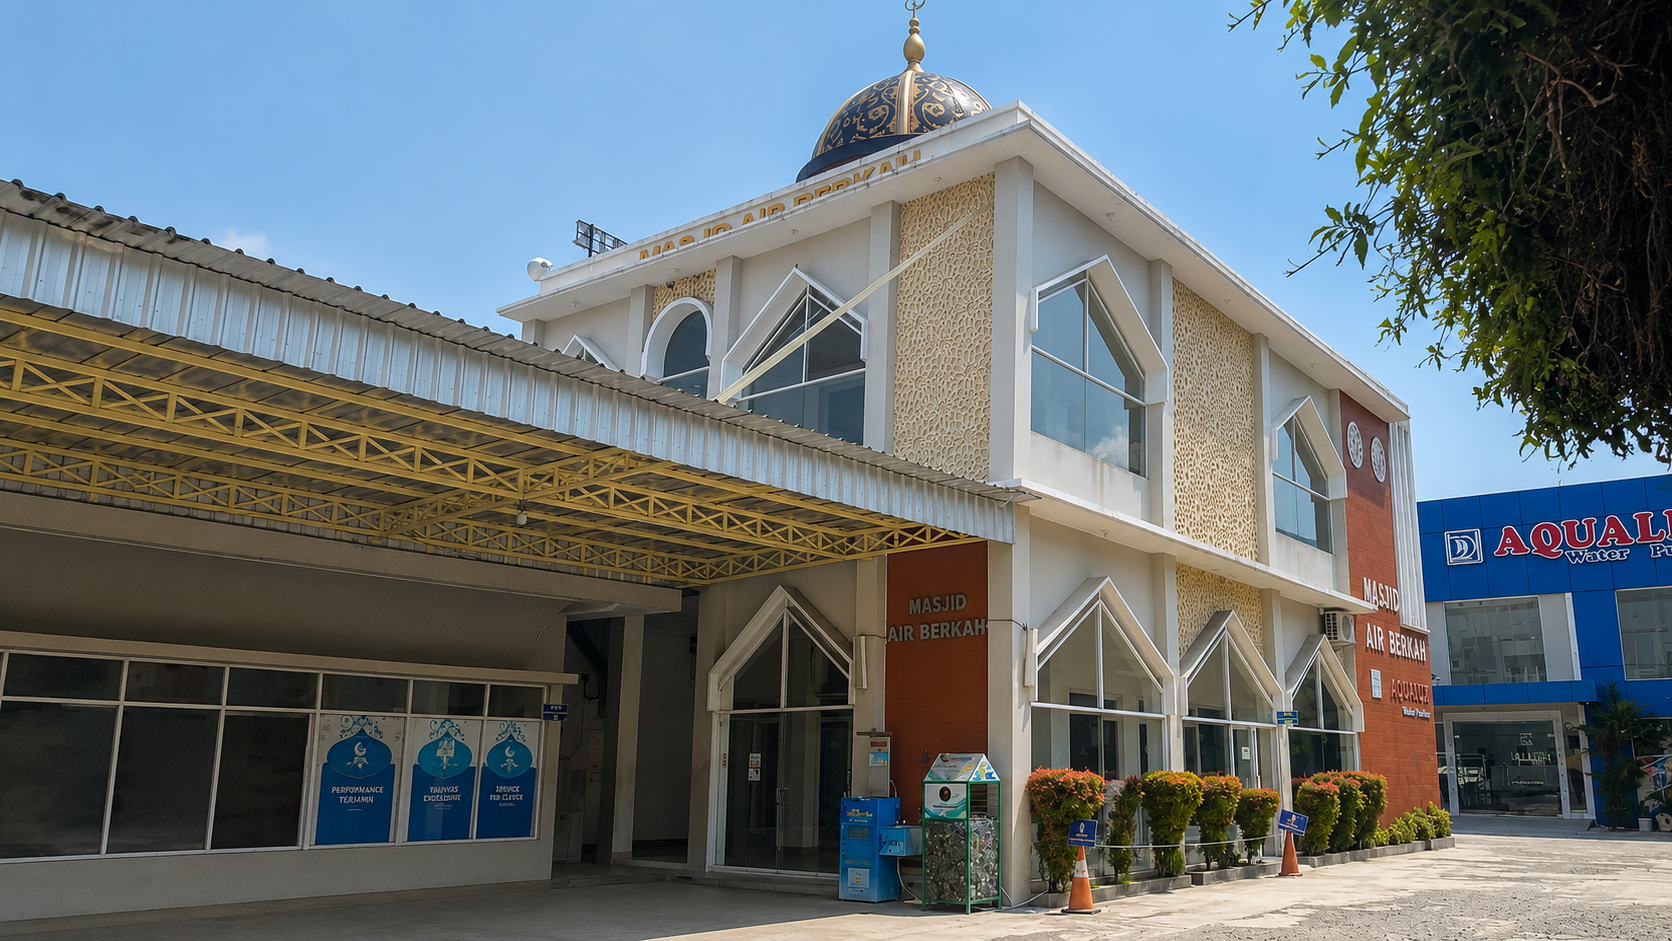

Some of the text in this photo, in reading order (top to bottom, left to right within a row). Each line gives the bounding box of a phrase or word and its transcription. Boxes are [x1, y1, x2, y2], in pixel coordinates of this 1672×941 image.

[1494, 509, 1672, 558] AQUAL
[1565, 549, 1630, 564] Water
[909, 593, 967, 615] MASJID
[1363, 576, 1399, 612] MASJID
[887, 618, 986, 643] AIR BERKAH
[1366, 622, 1427, 662] AIR BERKAH
